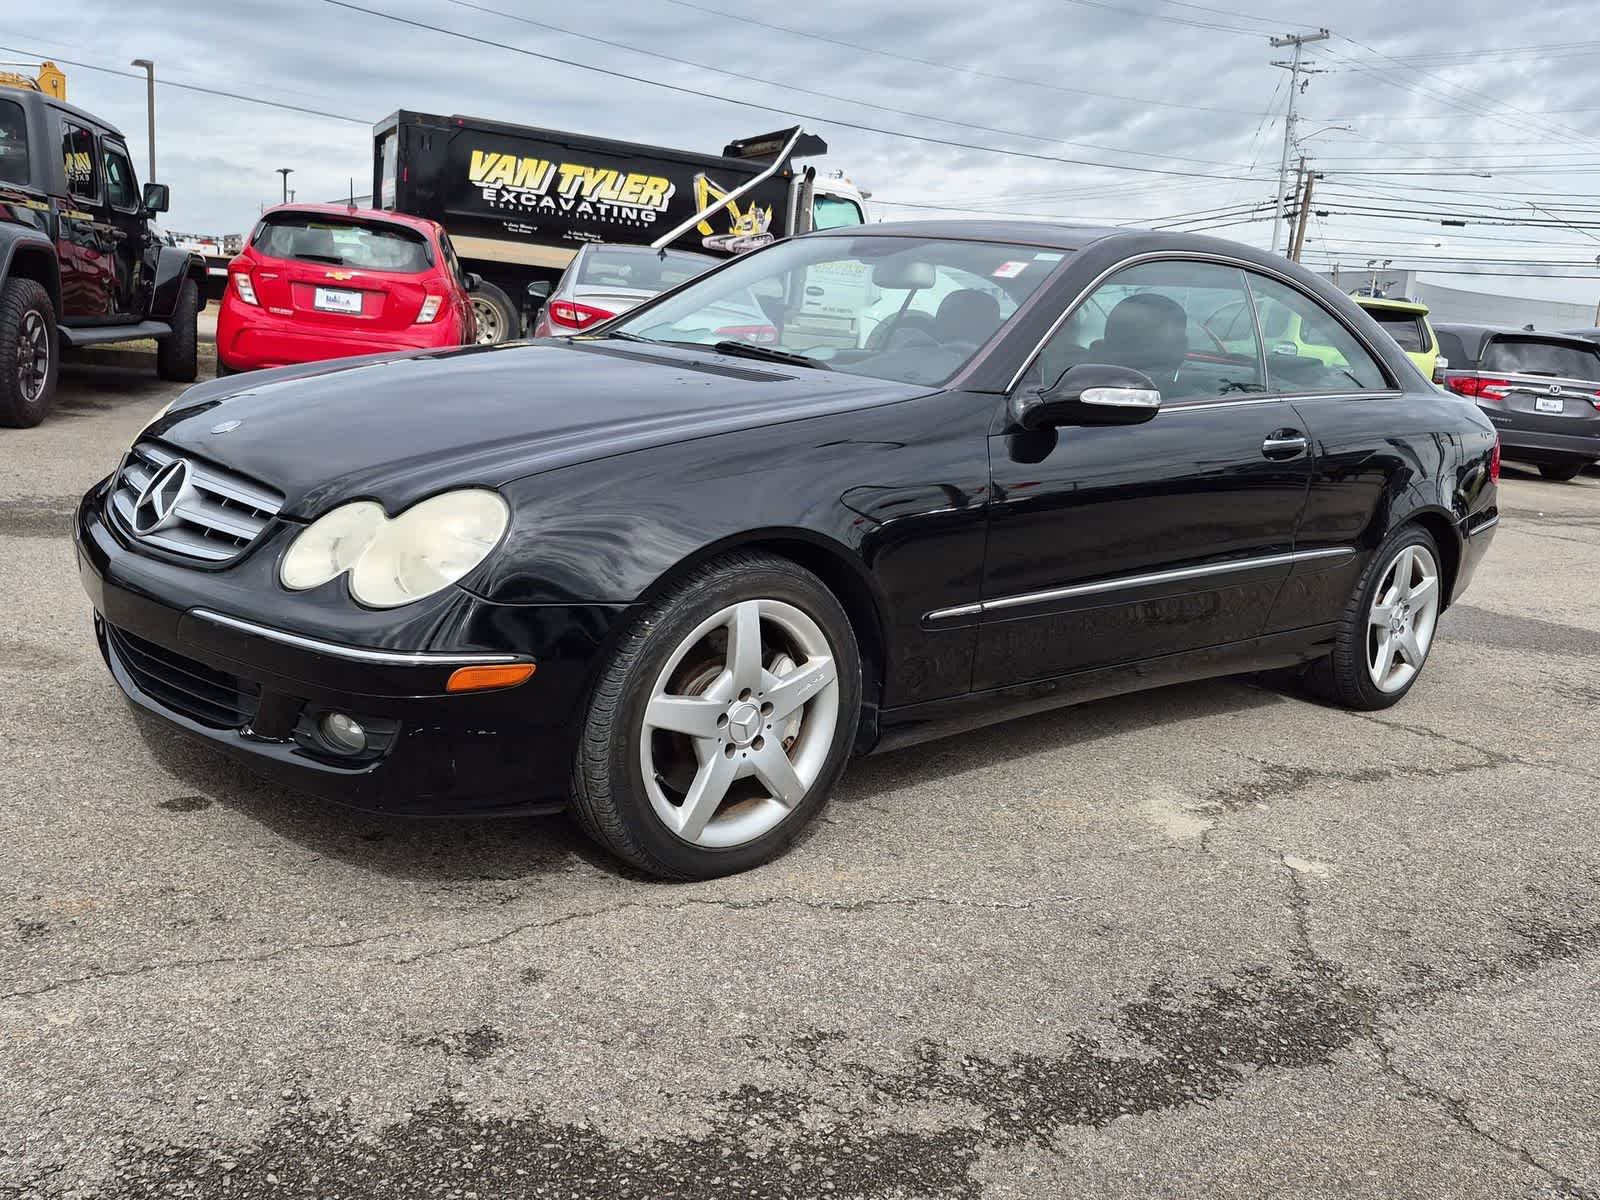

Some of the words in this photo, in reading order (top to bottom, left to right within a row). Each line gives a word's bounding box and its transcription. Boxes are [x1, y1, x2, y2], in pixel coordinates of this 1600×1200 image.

[468, 150, 558, 195] VAN
[557, 162, 676, 212] TYLER
[483, 188, 657, 222] EXCAVATING
